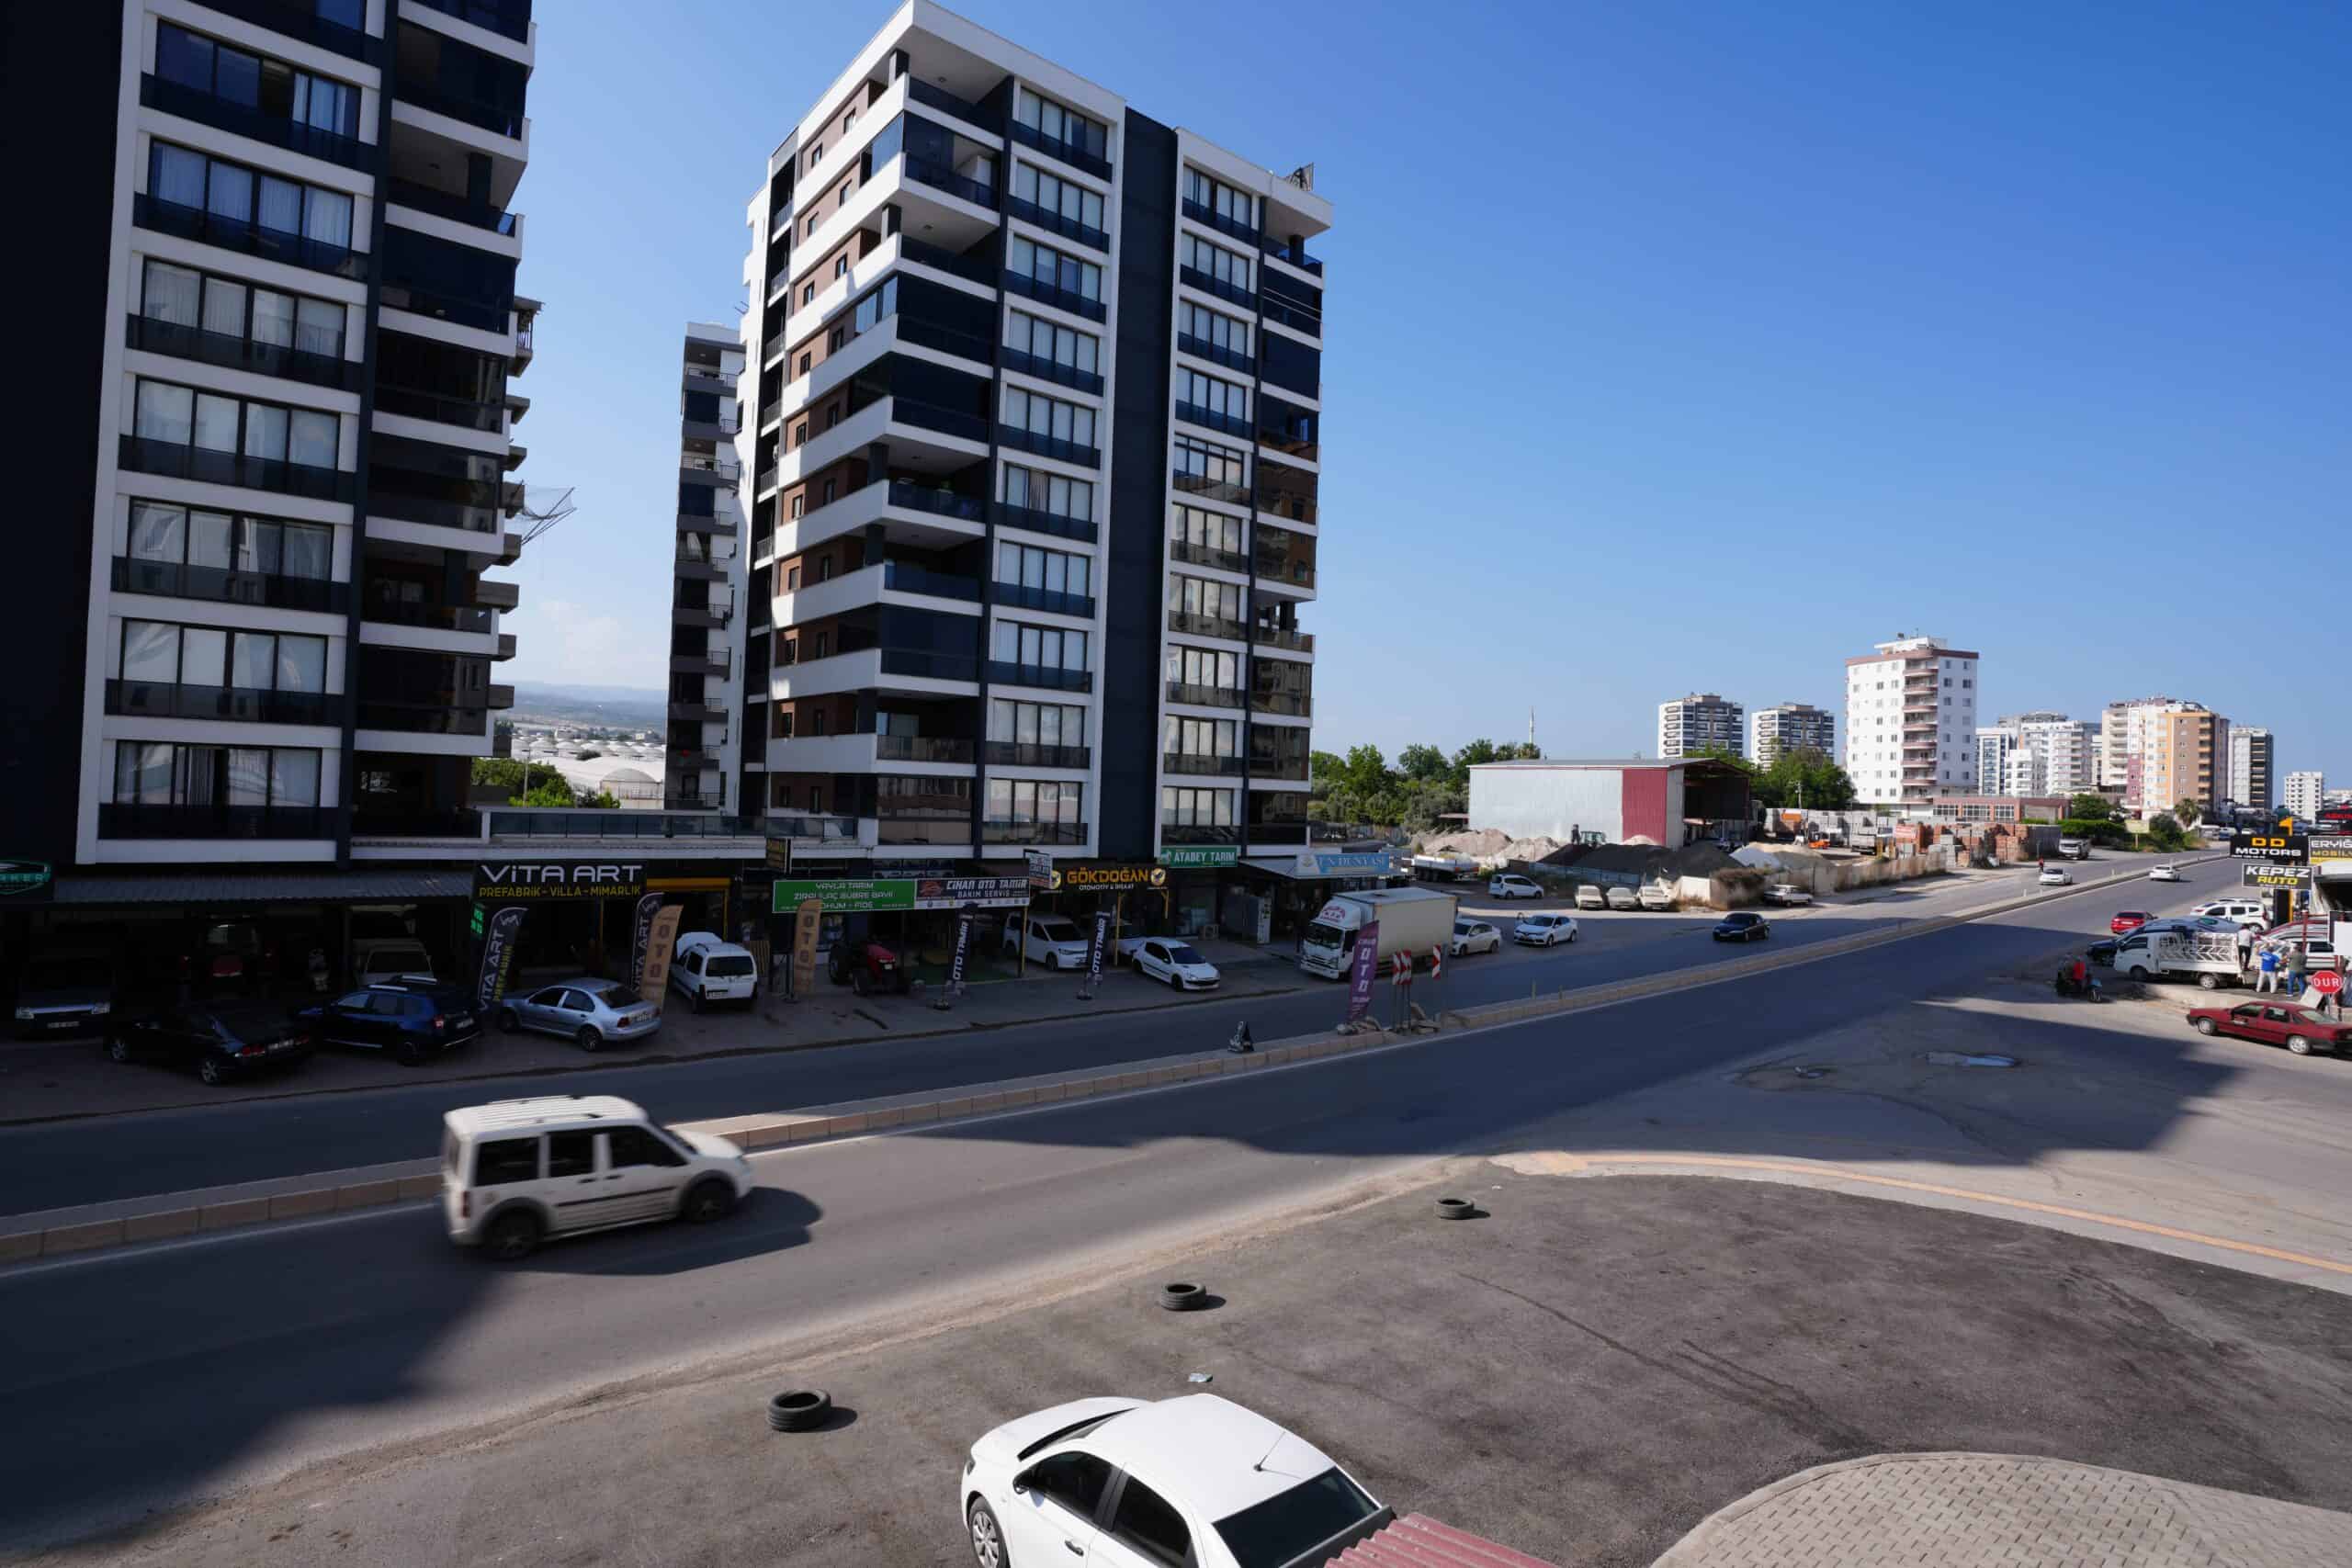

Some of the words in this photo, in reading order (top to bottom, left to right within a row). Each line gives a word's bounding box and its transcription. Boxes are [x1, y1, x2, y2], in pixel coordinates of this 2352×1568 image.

[1174, 852, 1206, 863] ATABEY
[1210, 851, 1236, 862] TARIM
[2235, 847, 2301, 856] MOTORS
[573, 864, 643, 883] ART
[1067, 866, 1148, 884] GÖKDOĞAN
[2245, 865, 2311, 878] KEPEZ
[978, 879, 996, 889] OTO
[2256, 875, 2299, 886] AUTO
[490, 930, 504, 966] ART
[1358, 947, 1373, 993] OTO
[2313, 977, 2339, 987] DUR
